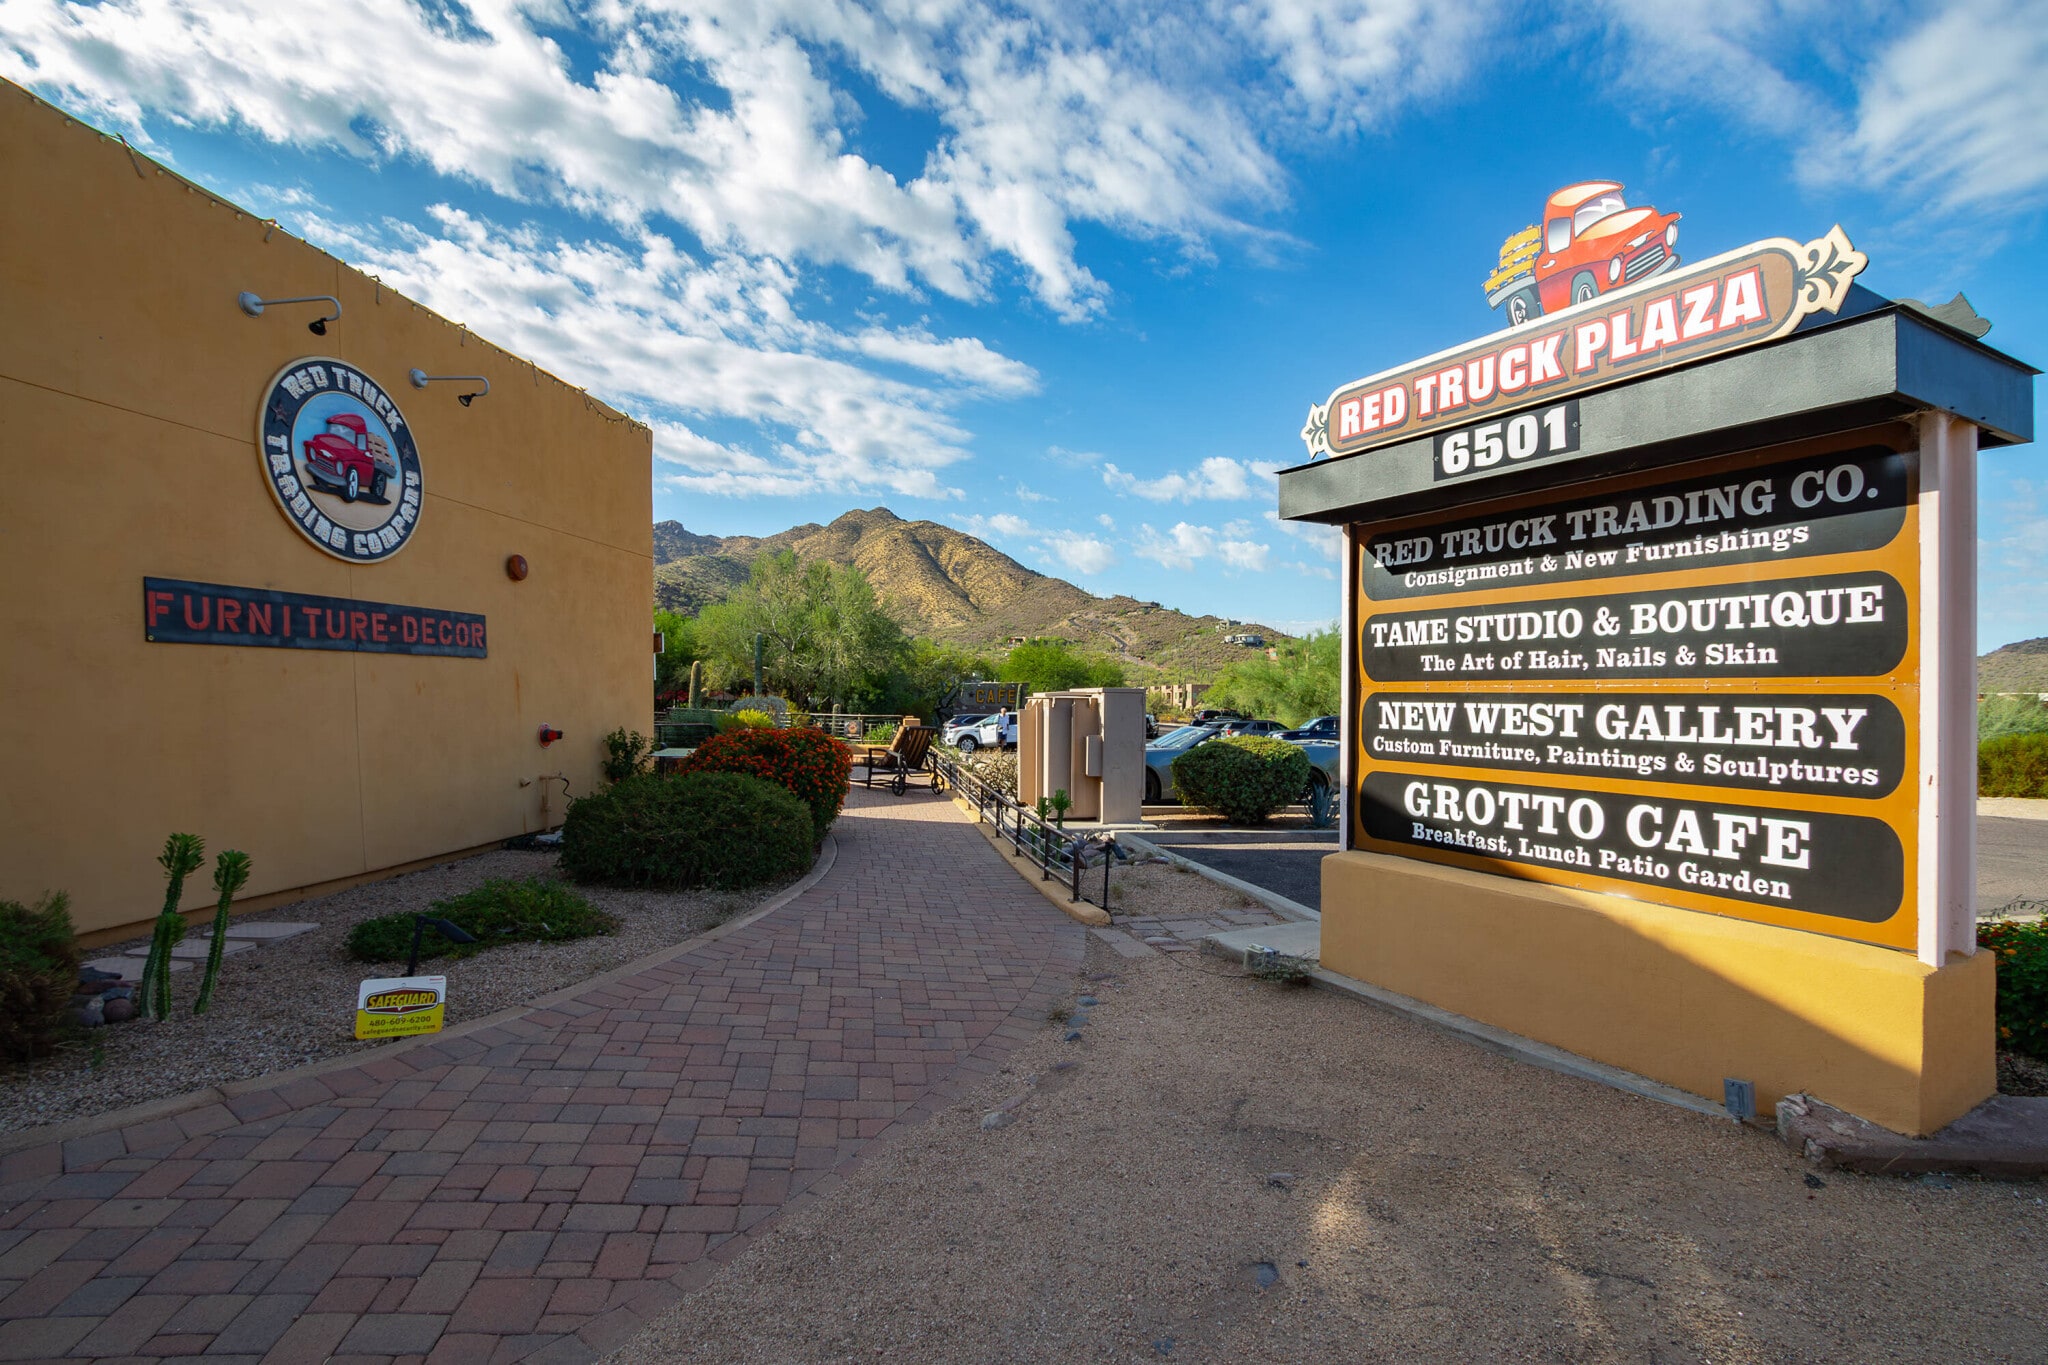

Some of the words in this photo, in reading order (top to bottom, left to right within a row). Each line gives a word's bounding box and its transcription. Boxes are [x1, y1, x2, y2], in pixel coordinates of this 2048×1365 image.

[1338, 384, 1408, 440] RED
[1414, 331, 1566, 419] TRUCK
[1574, 265, 1767, 374] PLAZA
[281, 365, 329, 400] RED
[331, 366, 403, 432] TRUCK
[1442, 406, 1567, 474] 6501
[267, 434, 348, 550] TRADING
[353, 471, 420, 555] COMPANY
[1373, 536, 1433, 568] RED
[1441, 515, 1557, 559] TRUCK
[1566, 478, 1776, 542] TRADING
[1790, 464, 1879, 508] CO.
[1405, 557, 1533, 587] Consignment
[1540, 554, 1557, 573] &
[1565, 550, 1618, 570] New
[1625, 525, 1809, 563] Furnishings
[1371, 618, 1448, 647] TAME
[1455, 608, 1583, 643] STUDIO
[1593, 606, 1620, 636] &
[1630, 585, 1884, 635] BOUTIQUE
[1420, 654, 1456, 671] The
[1460, 653, 1494, 671] Art
[1501, 652, 1524, 670] of
[1528, 650, 1589, 671] Hair,
[1596, 647, 1666, 668] Nails
[1675, 645, 1696, 666] &
[1705, 642, 1778, 665] Skin
[975, 689, 1016, 704] CAFE
[1379, 701, 1456, 732] NEW
[1464, 703, 1584, 738] WEST
[1595, 704, 1867, 751] GALLERY
[1373, 736, 1435, 755] Custom
[1439, 739, 1541, 764] Furniture,
[1547, 745, 1666, 775] Paintings
[1675, 752, 1695, 772] &
[1703, 754, 1879, 785] Sculptures
[1404, 781, 1605, 840] GROTTO
[1626, 804, 1810, 870] CAFE
[1412, 822, 1513, 856] Breakfast,
[1519, 837, 1591, 866] Lunch
[1599, 849, 1669, 878] Patio
[1678, 861, 1792, 900] Garden
[367, 992, 436, 1009] SAFEGUARD
[369, 1016, 431, 1027] 480-609-6200
